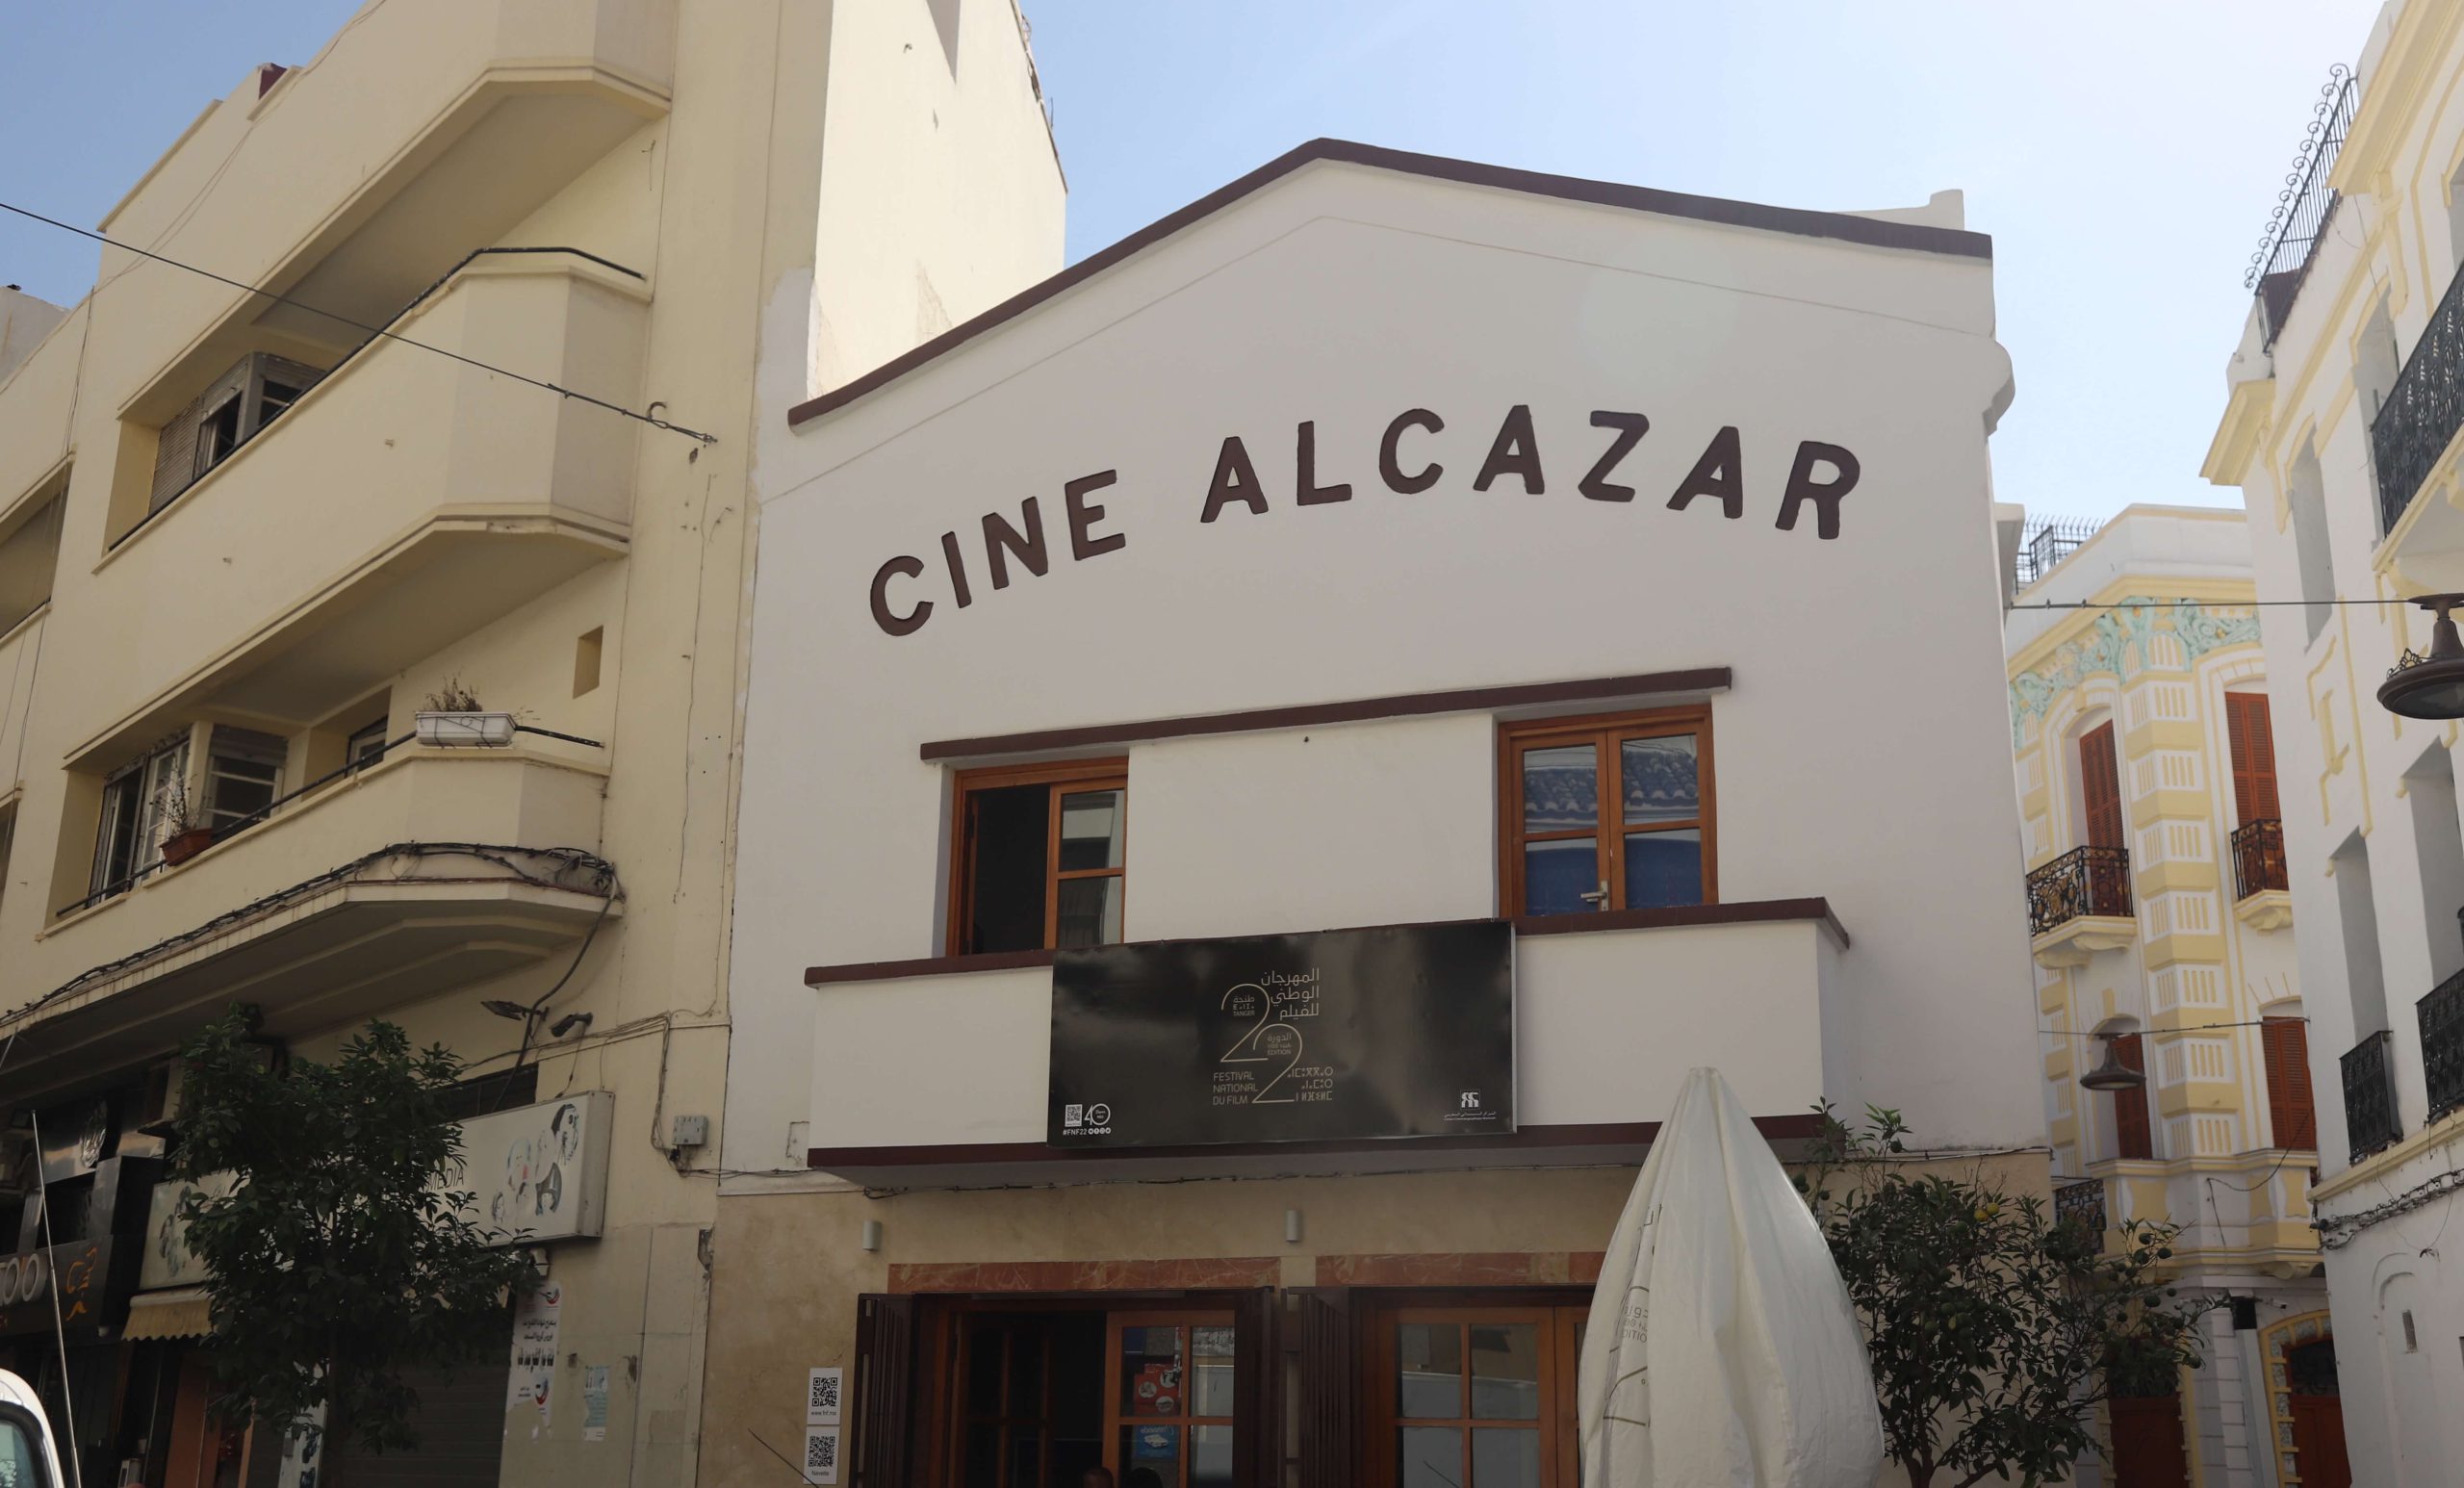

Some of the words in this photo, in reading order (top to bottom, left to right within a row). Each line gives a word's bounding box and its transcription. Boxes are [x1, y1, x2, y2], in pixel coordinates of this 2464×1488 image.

[870, 468, 1126, 637] CINE
[1199, 404, 1861, 541] ALCAZAR
[1261, 968, 1320, 987] المهرجان
[1270, 986, 1320, 1007] الوطني
[1279, 1002, 1320, 1021] للفيلم
[1213, 1070, 1255, 1082] FESTIVAL
[1213, 1083, 1259, 1094] NATIONAL
[1213, 1095, 1225, 1106] DU
[1227, 1094, 1247, 1105] FILM
[1063, 1127, 1088, 1136] #FNF22
